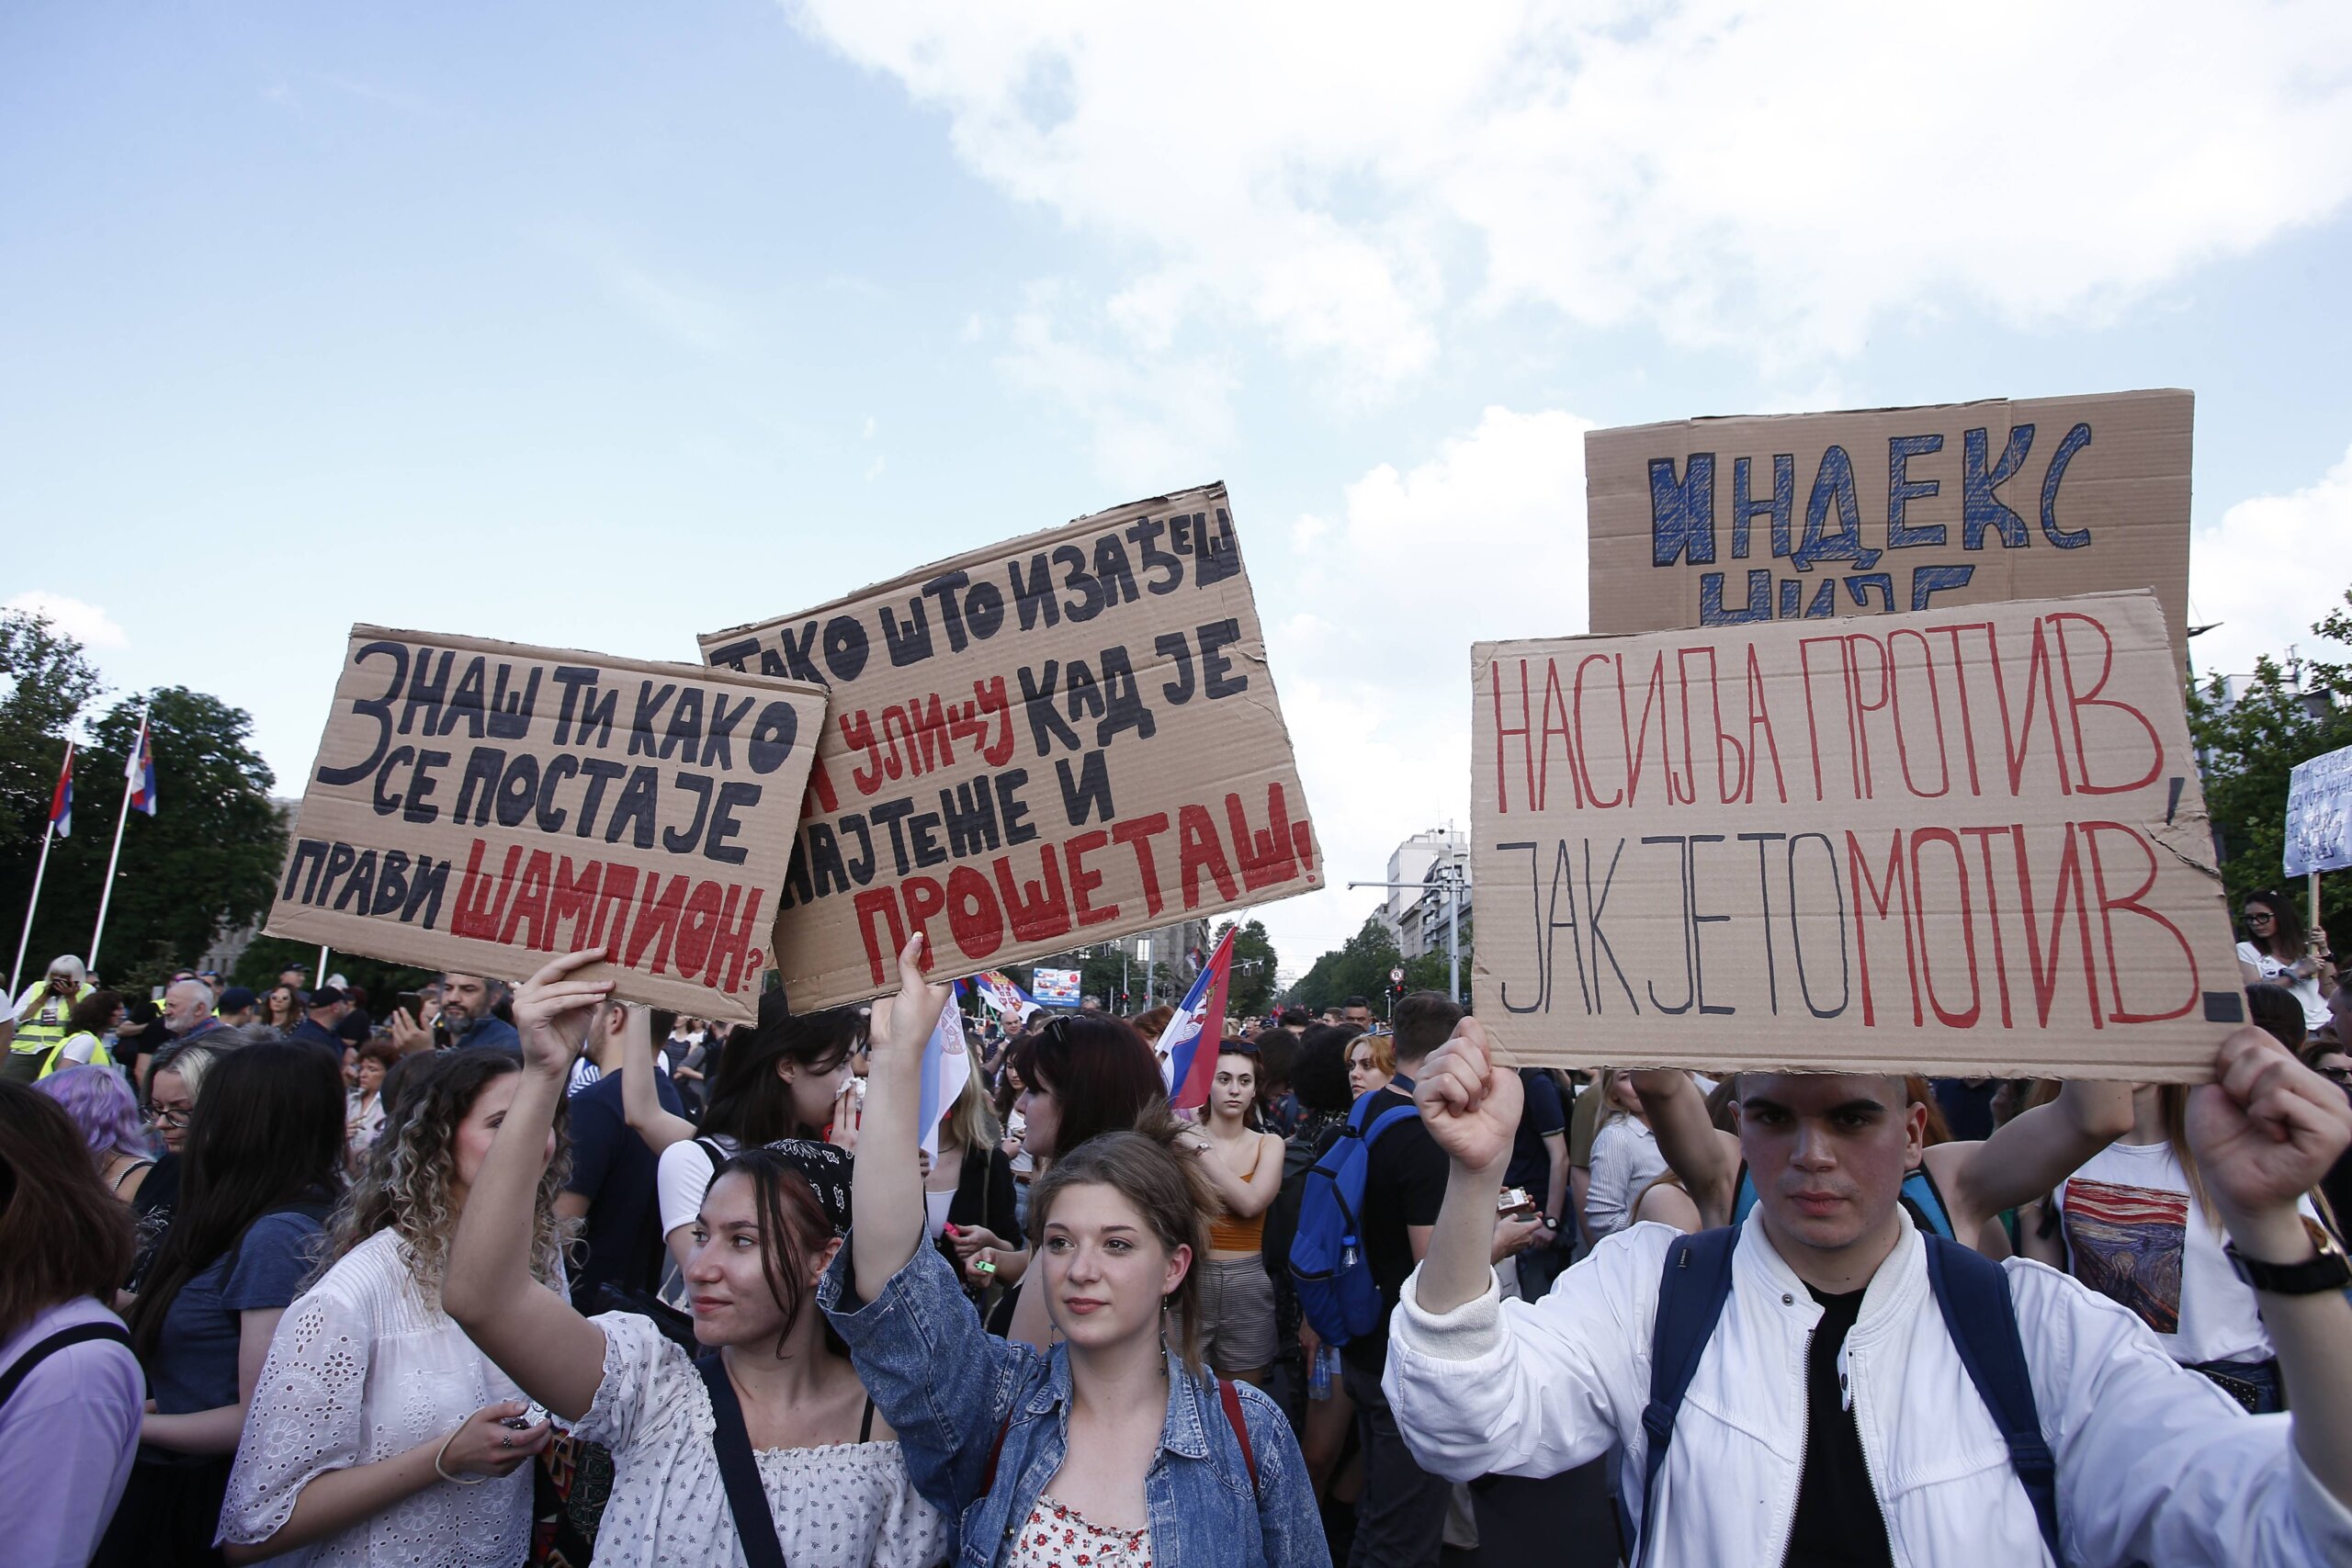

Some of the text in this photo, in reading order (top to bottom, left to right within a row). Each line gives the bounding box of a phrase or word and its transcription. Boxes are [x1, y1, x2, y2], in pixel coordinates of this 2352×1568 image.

[1648, 423, 2092, 571] ИНДЕКС
[709, 508, 1241, 693] ТАКО ШТО ИЗАЂЕШ
[316, 641, 798, 786] ЗНАШ ТИ КАКО
[840, 676, 1014, 795] УЛИЦУ
[1017, 646, 1156, 757] КАД
[1155, 618, 1248, 705] ЈЕ
[1055, 749, 1115, 827] И
[1493, 613, 2185, 826] НАСИЉА ПРОТИВ,
[373, 745, 762, 865] СЕ ПОСТАЈЕ
[854, 783, 1315, 987] ПРОШЕТАШ!
[282, 839, 765, 993] ПРАВИ ШАМПИОН?
[1845, 821, 2245, 1030] МОТИВ.
